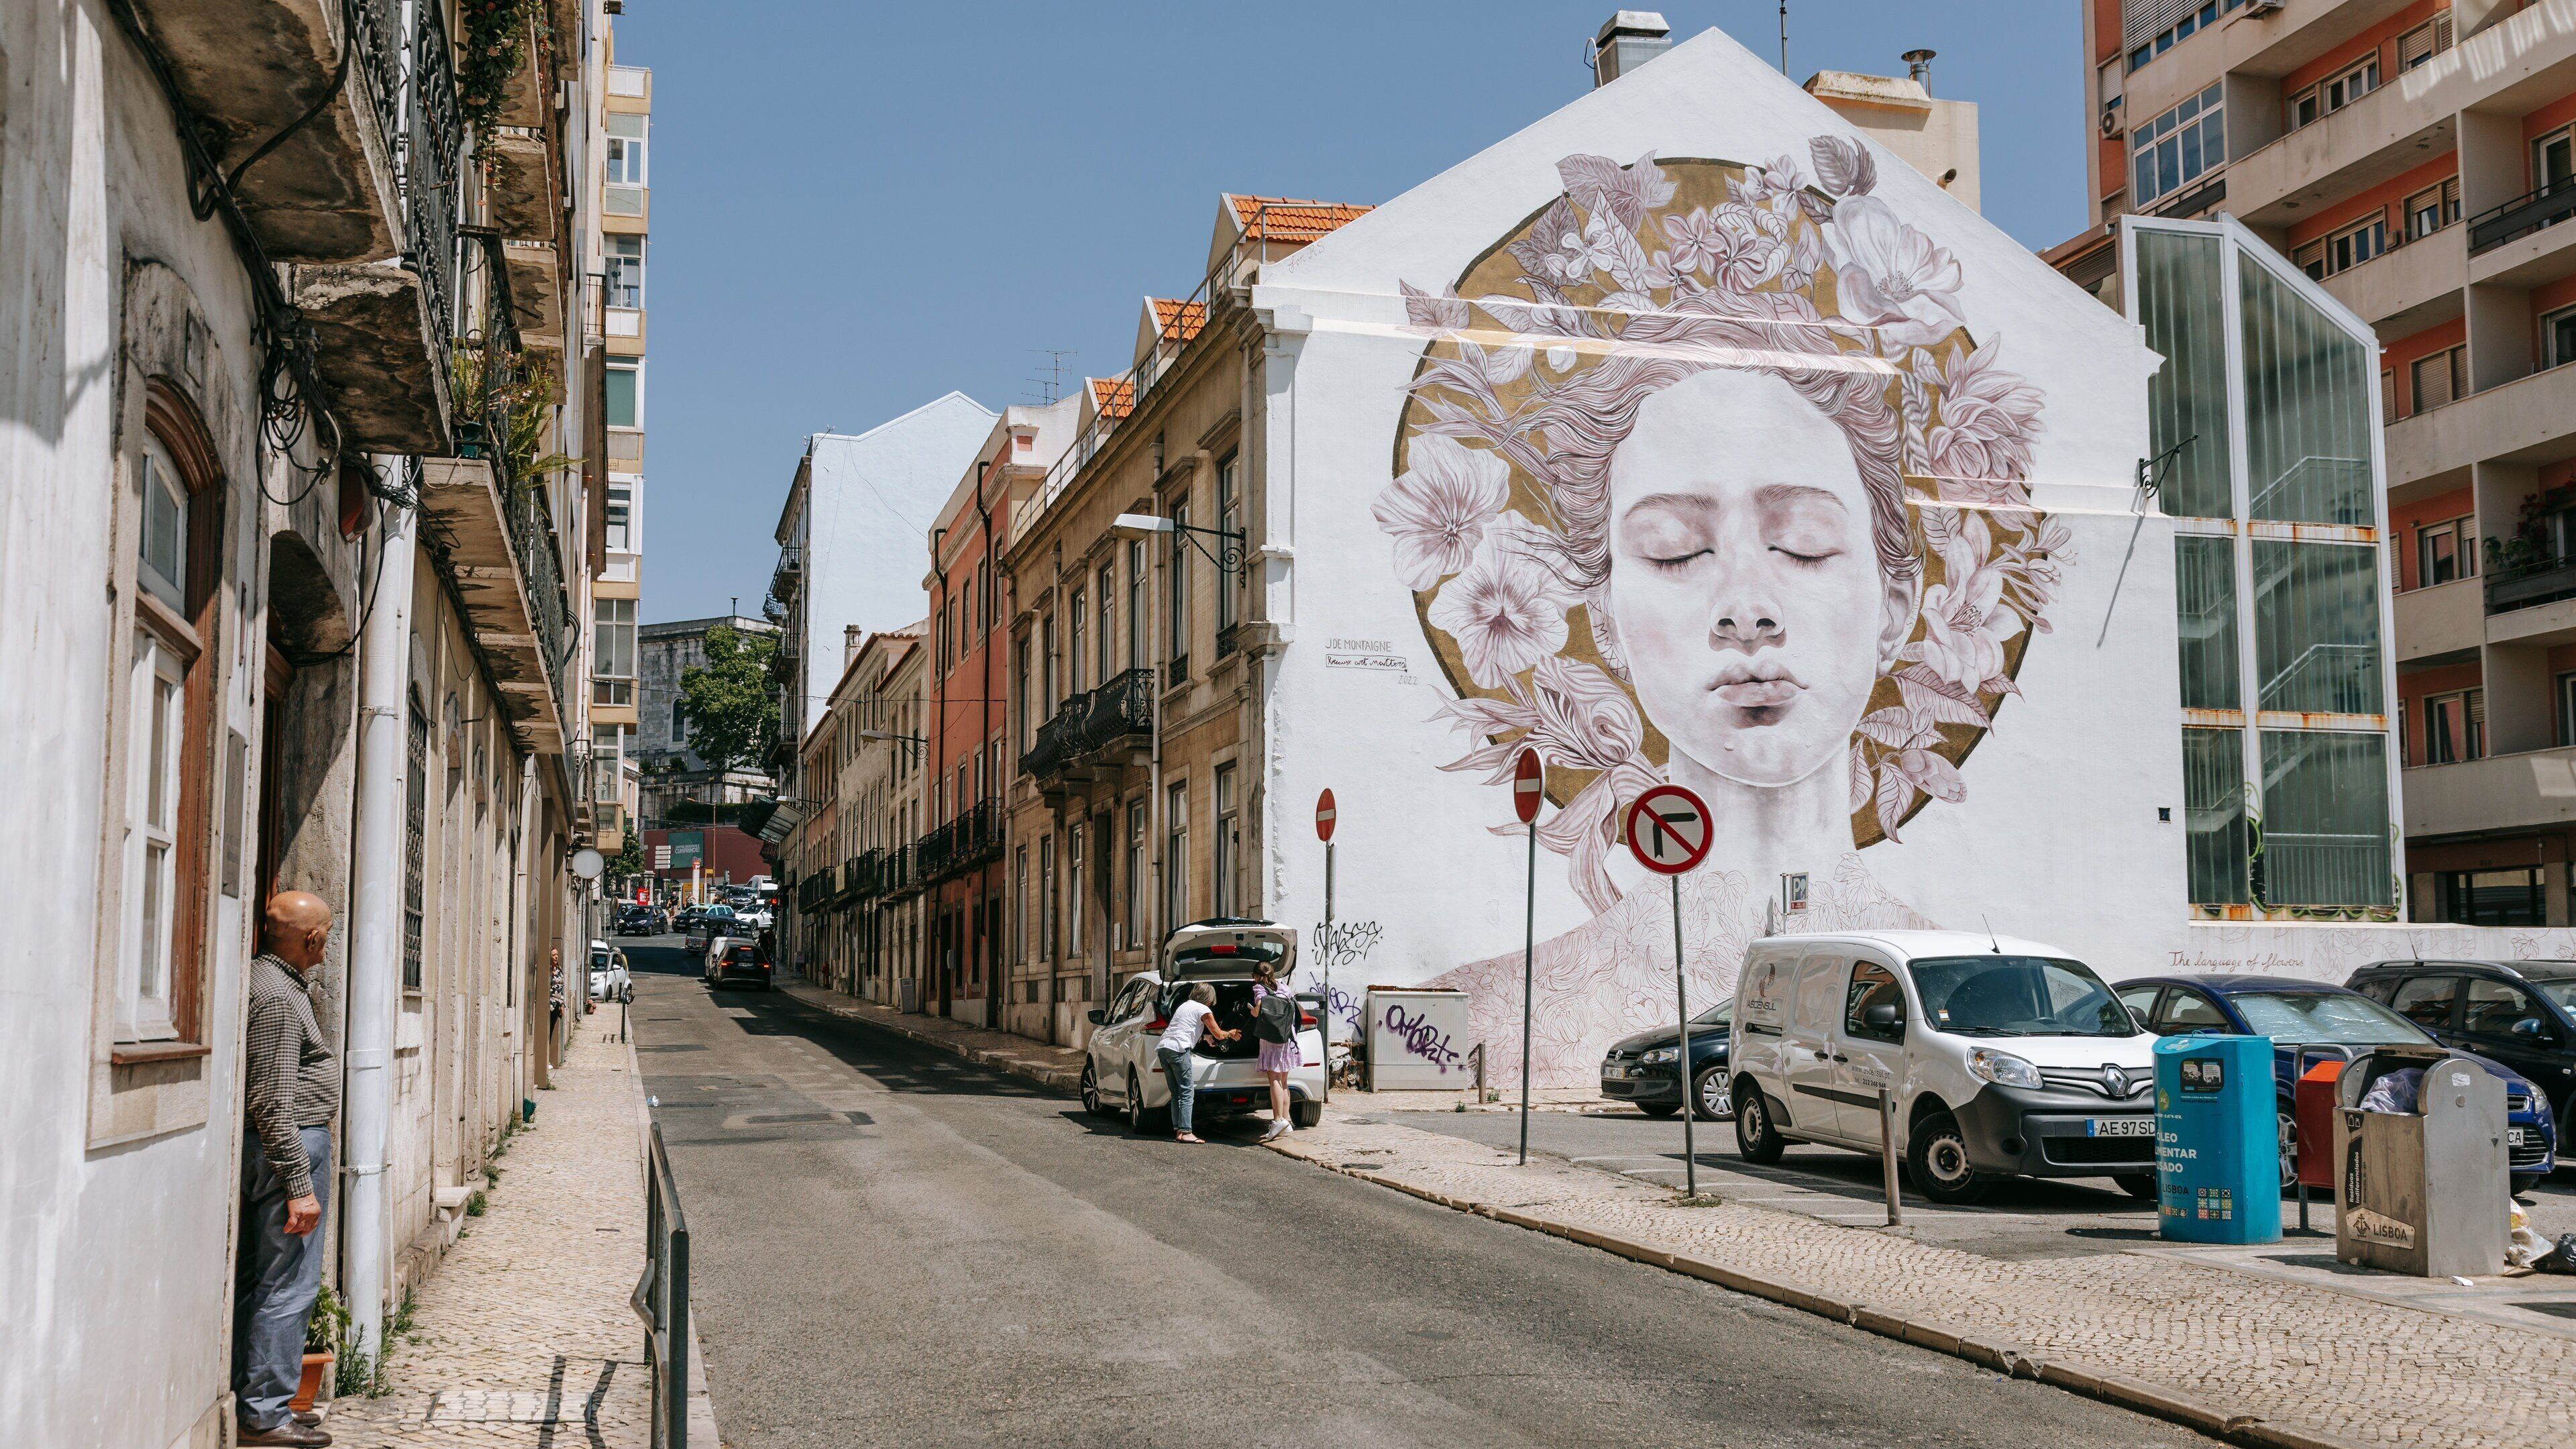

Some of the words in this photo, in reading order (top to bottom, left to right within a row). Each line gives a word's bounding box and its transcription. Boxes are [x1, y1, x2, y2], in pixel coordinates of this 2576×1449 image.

[1332, 639, 1342, 649] DE
[1344, 639, 1393, 652] MONTAIGNE
[1355, 657, 1368, 666] art
[1370, 658, 1406, 668] matters
[1398, 675, 1417, 685] 2022
[2168, 951, 2190, 967] The
[2194, 951, 2242, 972] language
[2247, 953, 2259, 971] of
[2261, 953, 2304, 972] flowers
[2099, 1122, 2119, 1135] AE
[2121, 1122, 2137, 1135] 97
[2155, 1146, 2197, 1159] LIMENTAR
[2156, 1161, 2184, 1173] USADO
[2162, 1183, 2190, 1195] LISBOA
[2373, 1224, 2408, 1241] LISBOA
